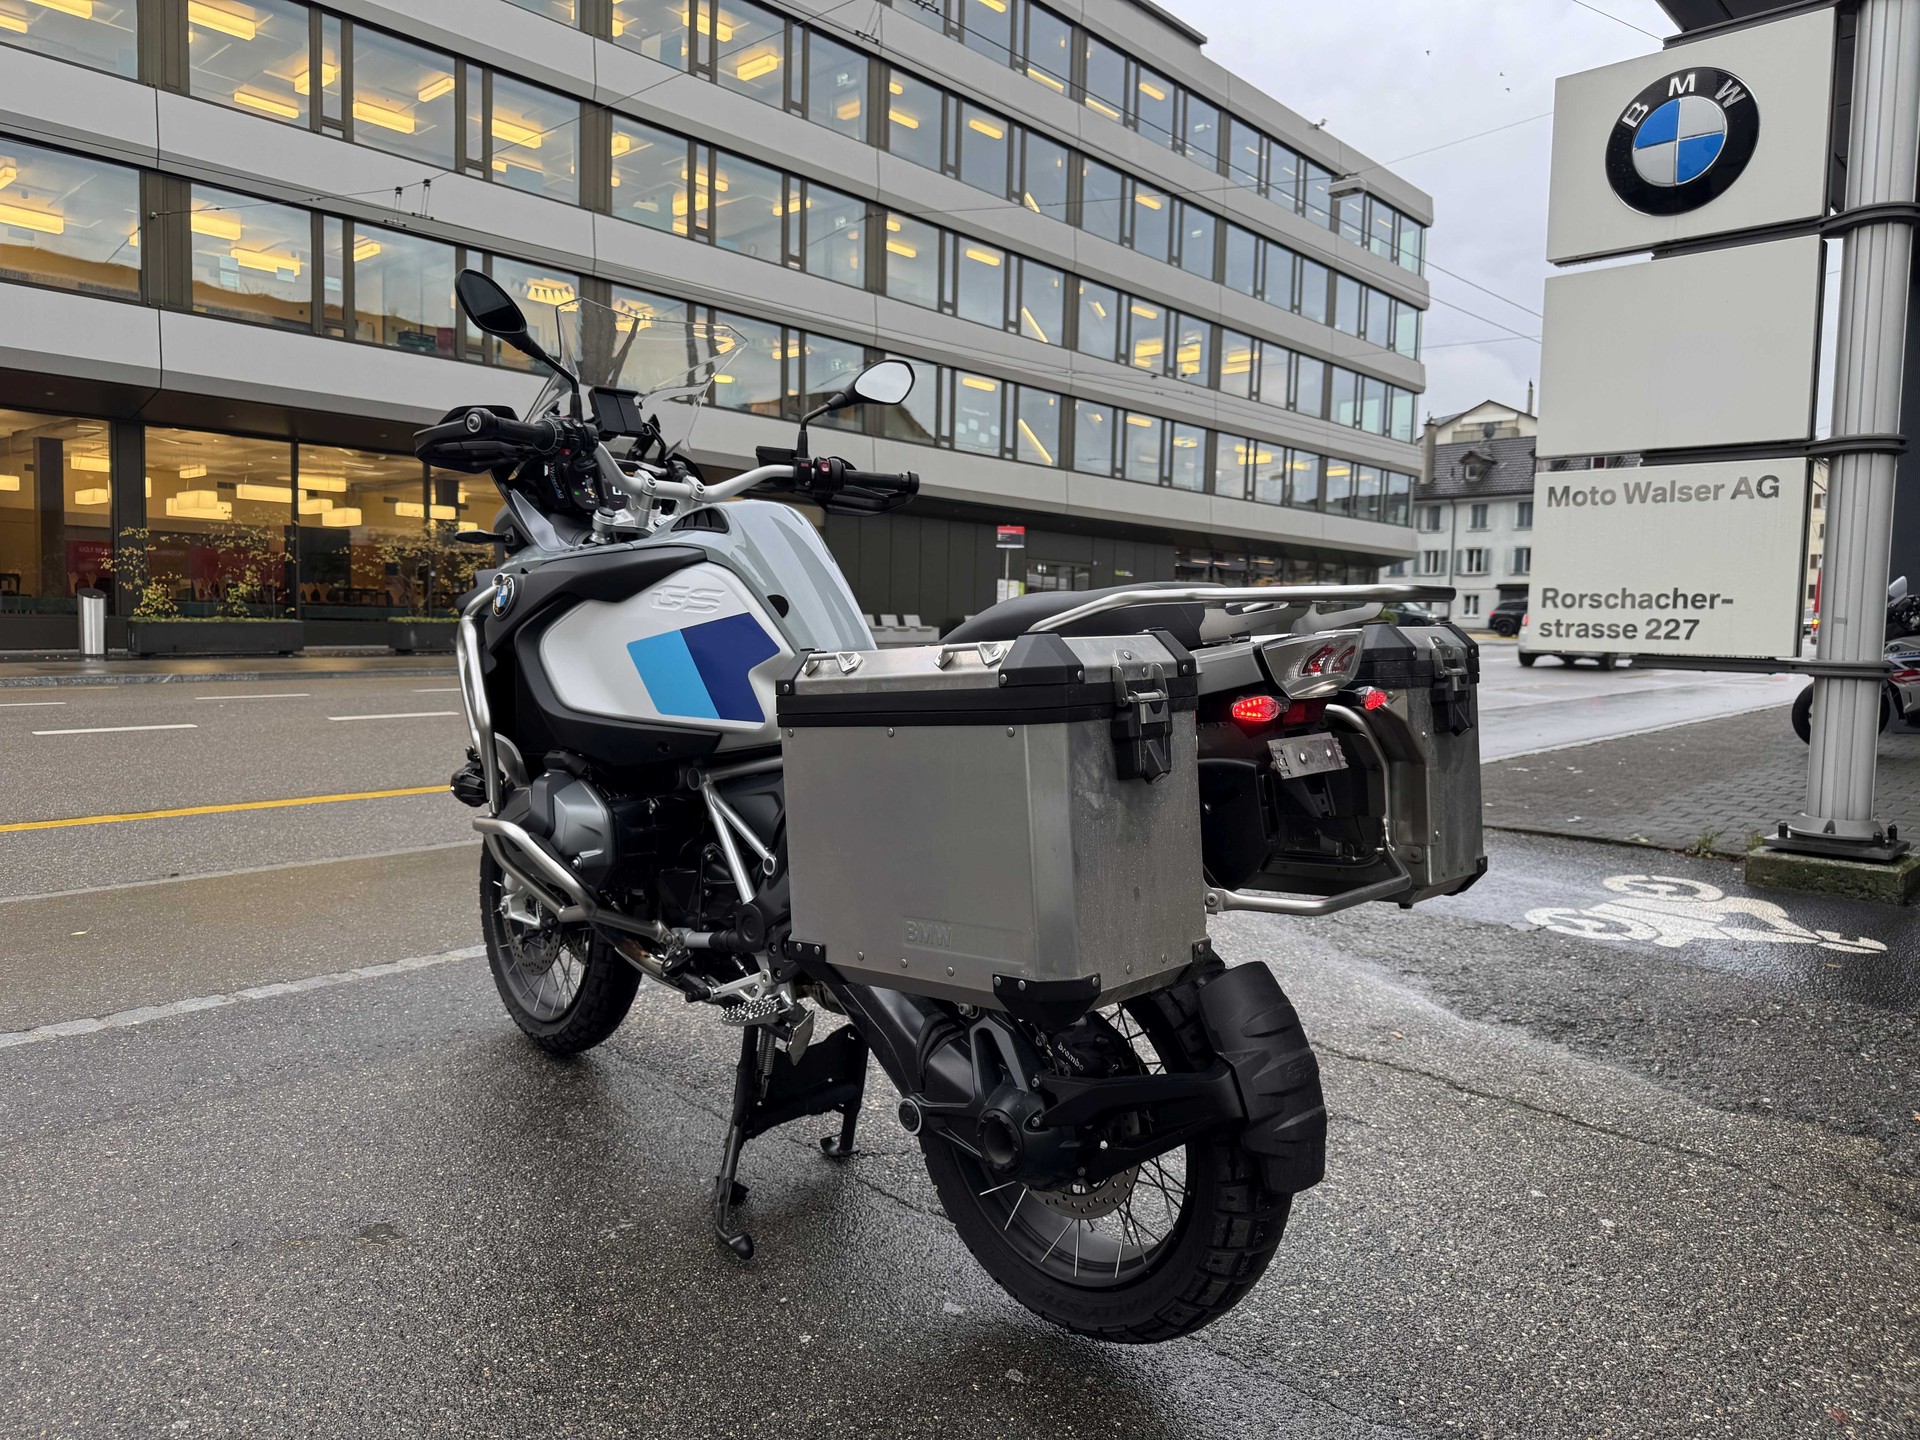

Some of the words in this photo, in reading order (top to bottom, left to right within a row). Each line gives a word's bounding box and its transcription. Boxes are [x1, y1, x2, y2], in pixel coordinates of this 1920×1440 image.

[1622, 73, 1747, 127] BMW
[1547, 486, 1616, 507] Moto
[1623, 480, 1725, 504] Walser
[1730, 475, 1780, 501] AG
[648, 584, 726, 614] GS
[1541, 587, 1734, 610] Rorschacher-
[1538, 619, 1638, 640] strasse
[1644, 618, 1700, 641] 227
[906, 920, 952, 947] BMW
[1057, 1041, 1084, 1071] brembo
